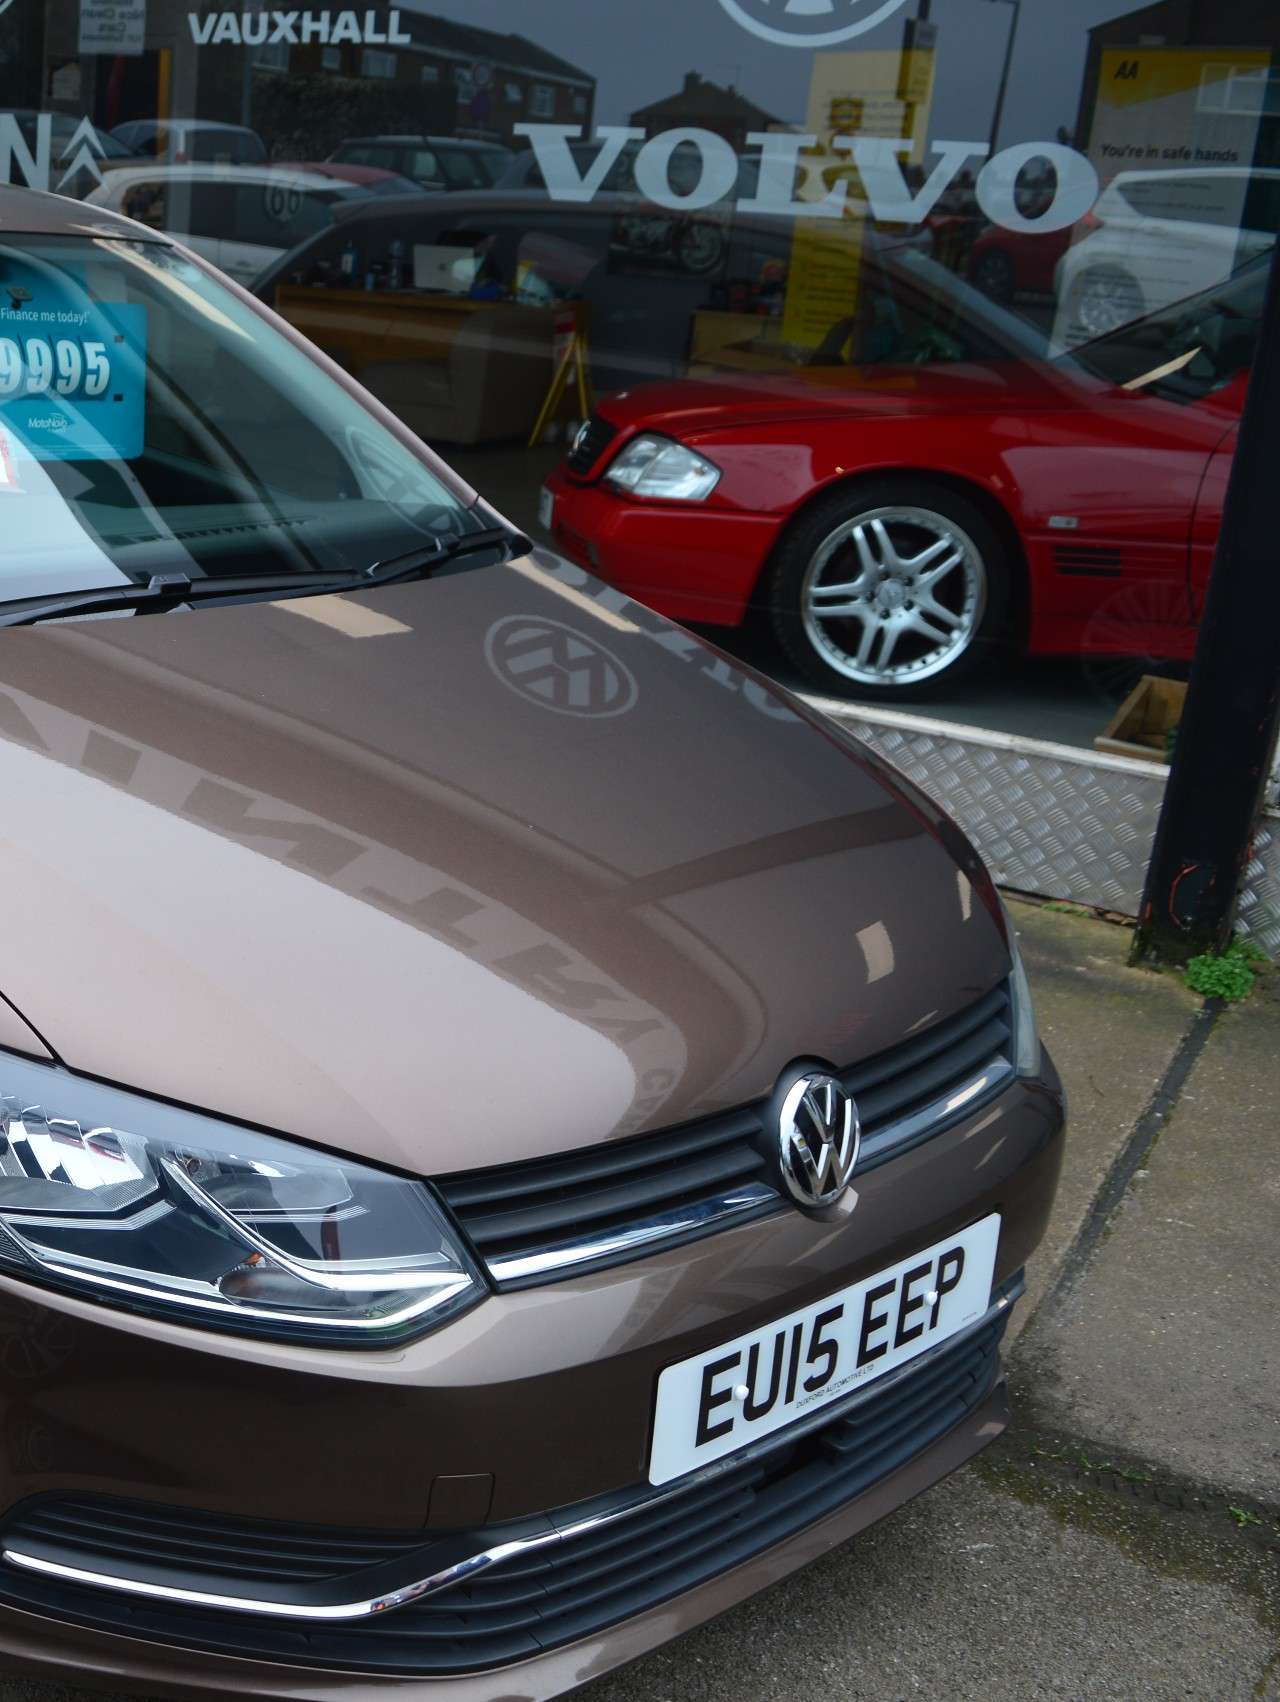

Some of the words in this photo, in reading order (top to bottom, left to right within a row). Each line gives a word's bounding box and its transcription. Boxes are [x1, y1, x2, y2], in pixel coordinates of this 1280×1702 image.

[188, 10, 412, 45] VAUXHALL
[1113, 61, 1139, 79] AA
[1102, 144, 1144, 159] You're
[1146, 144, 1159, 159] in
[1162, 145, 1191, 160] safe
[1193, 147, 1239, 162] hands
[513, 122, 1099, 235] VOLVO
[0, 307, 39, 321] Finance
[41, 311, 56, 322] me
[695, 1303, 845, 1448] EU15
[856, 1246, 965, 1369] EEP
